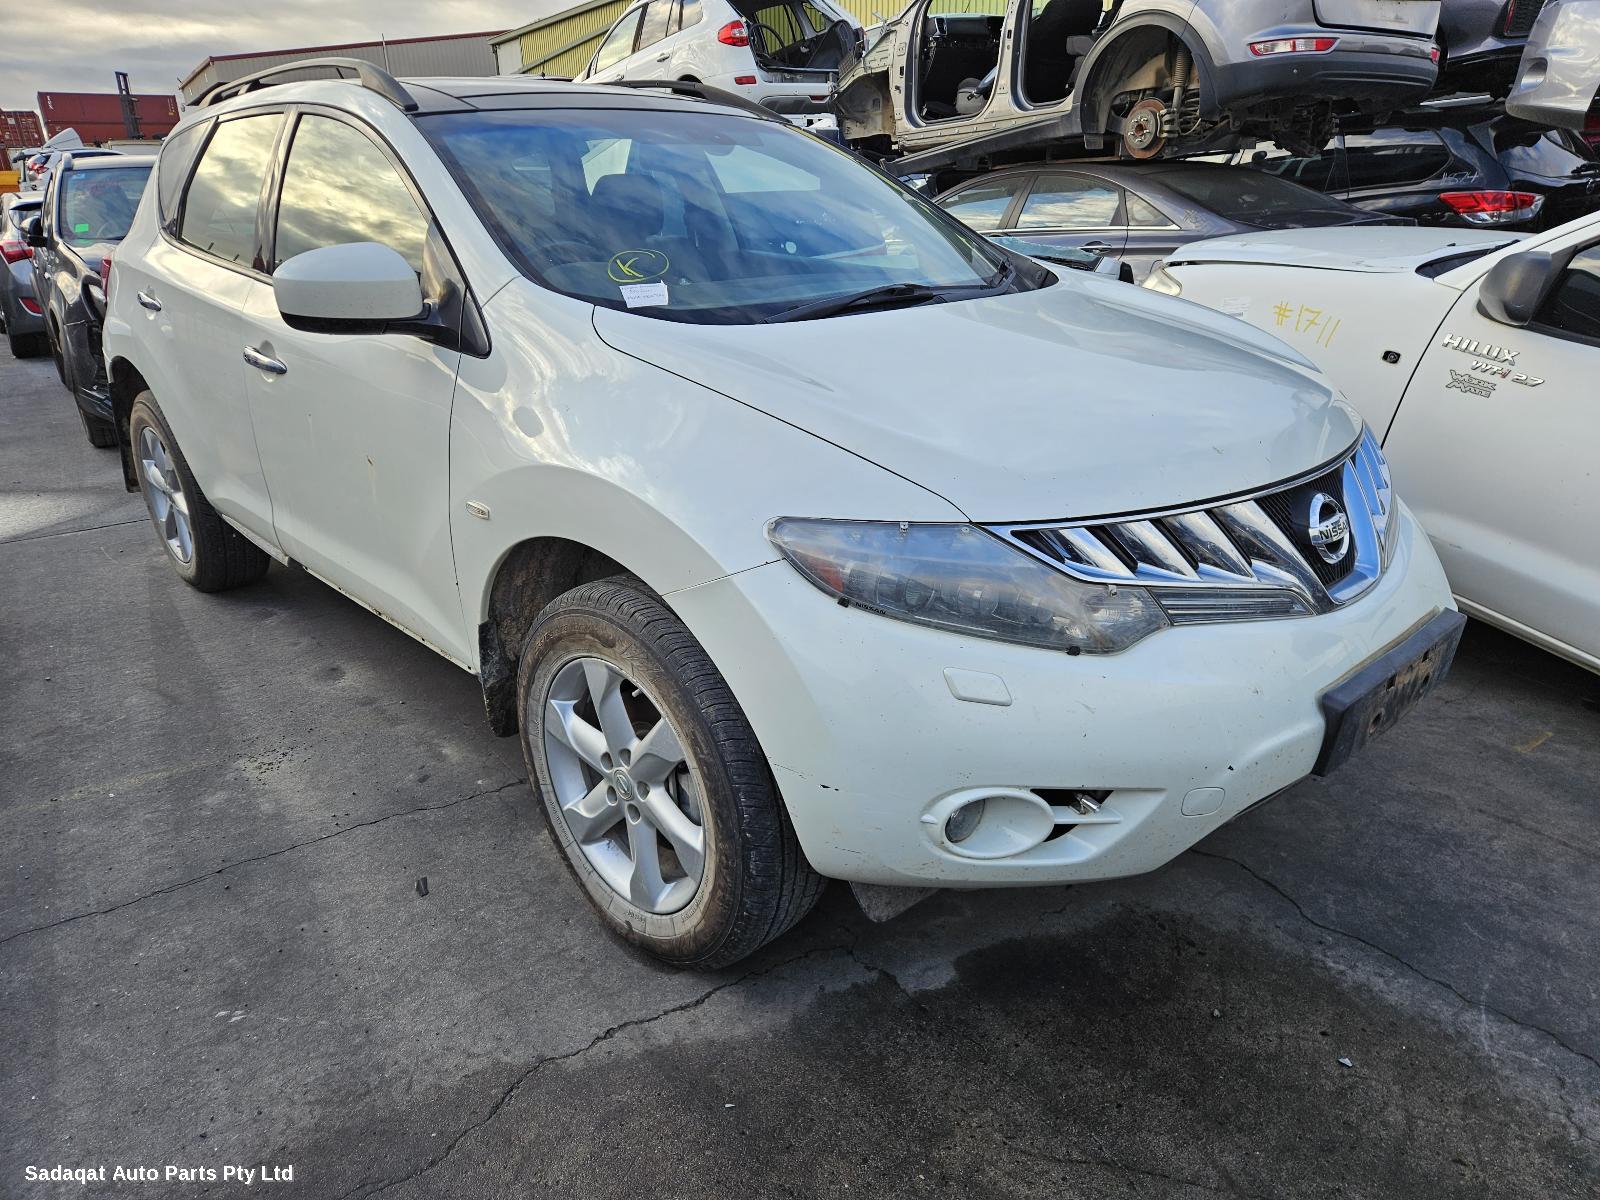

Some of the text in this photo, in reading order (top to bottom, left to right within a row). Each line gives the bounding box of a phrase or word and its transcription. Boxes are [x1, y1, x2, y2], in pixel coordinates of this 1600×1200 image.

[616, 257, 644, 277] K
[1273, 301, 1342, 348] #1711
[1442, 333, 1520, 366] HILUX
[855, 601, 887, 615] NISSAN
